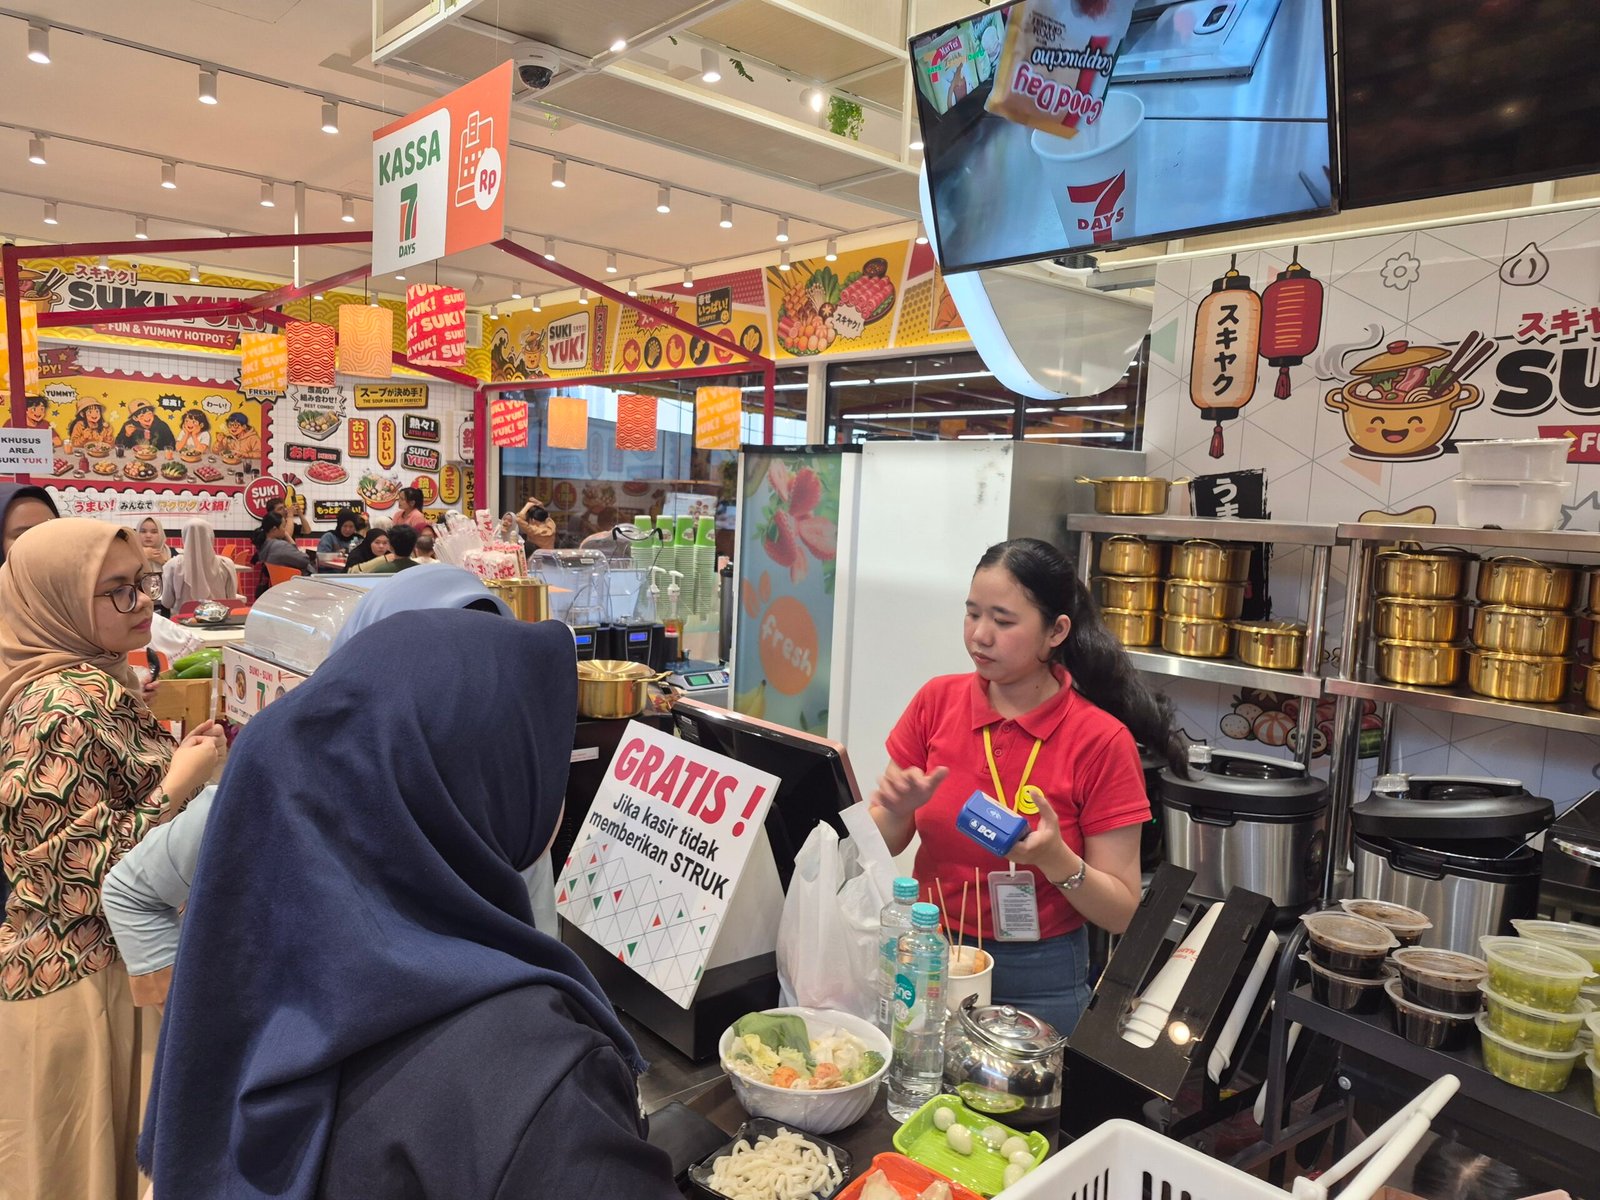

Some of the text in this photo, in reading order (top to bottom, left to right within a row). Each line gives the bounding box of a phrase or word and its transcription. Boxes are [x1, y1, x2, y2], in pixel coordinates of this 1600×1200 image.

[1031, 46, 1113, 77] Cappuccino
[1012, 63, 1104, 125] Good Day
[379, 129, 441, 186] KASSA
[479, 169, 497, 195] Rp
[399, 183, 418, 243] 7
[1067, 169, 1126, 245] 7
[1077, 206, 1124, 232] DAYS
[399, 242, 416, 258] DAYS
[408, 296, 437, 320] YUK!
[421, 310, 460, 332] SUKI
[108, 322, 225, 345] FUN & YUMMY HOTPOT
[550, 323, 572, 340] SUKI
[550, 333, 586, 363] YUK!
[1212, 304, 1240, 396] スキヤク
[46, 389, 75, 398] YUMMY!
[360, 387, 423, 398] スープが決め手!
[1, 437, 41, 445] KHUSUS
[381, 421, 391, 461] おいしい
[409, 446, 429, 456] SUKI
[407, 454, 437, 470] YUK!
[251, 484, 279, 498] SUKI
[74, 499, 116, 514] うまい!
[120, 500, 153, 512] みんなで
[761, 614, 812, 677] fresh
[613, 737, 767, 838] GRATIS !
[613, 793, 720, 863] Jika kasir tidak
[977, 824, 997, 841] BCA
[589, 810, 731, 900] memberikan STRUK
